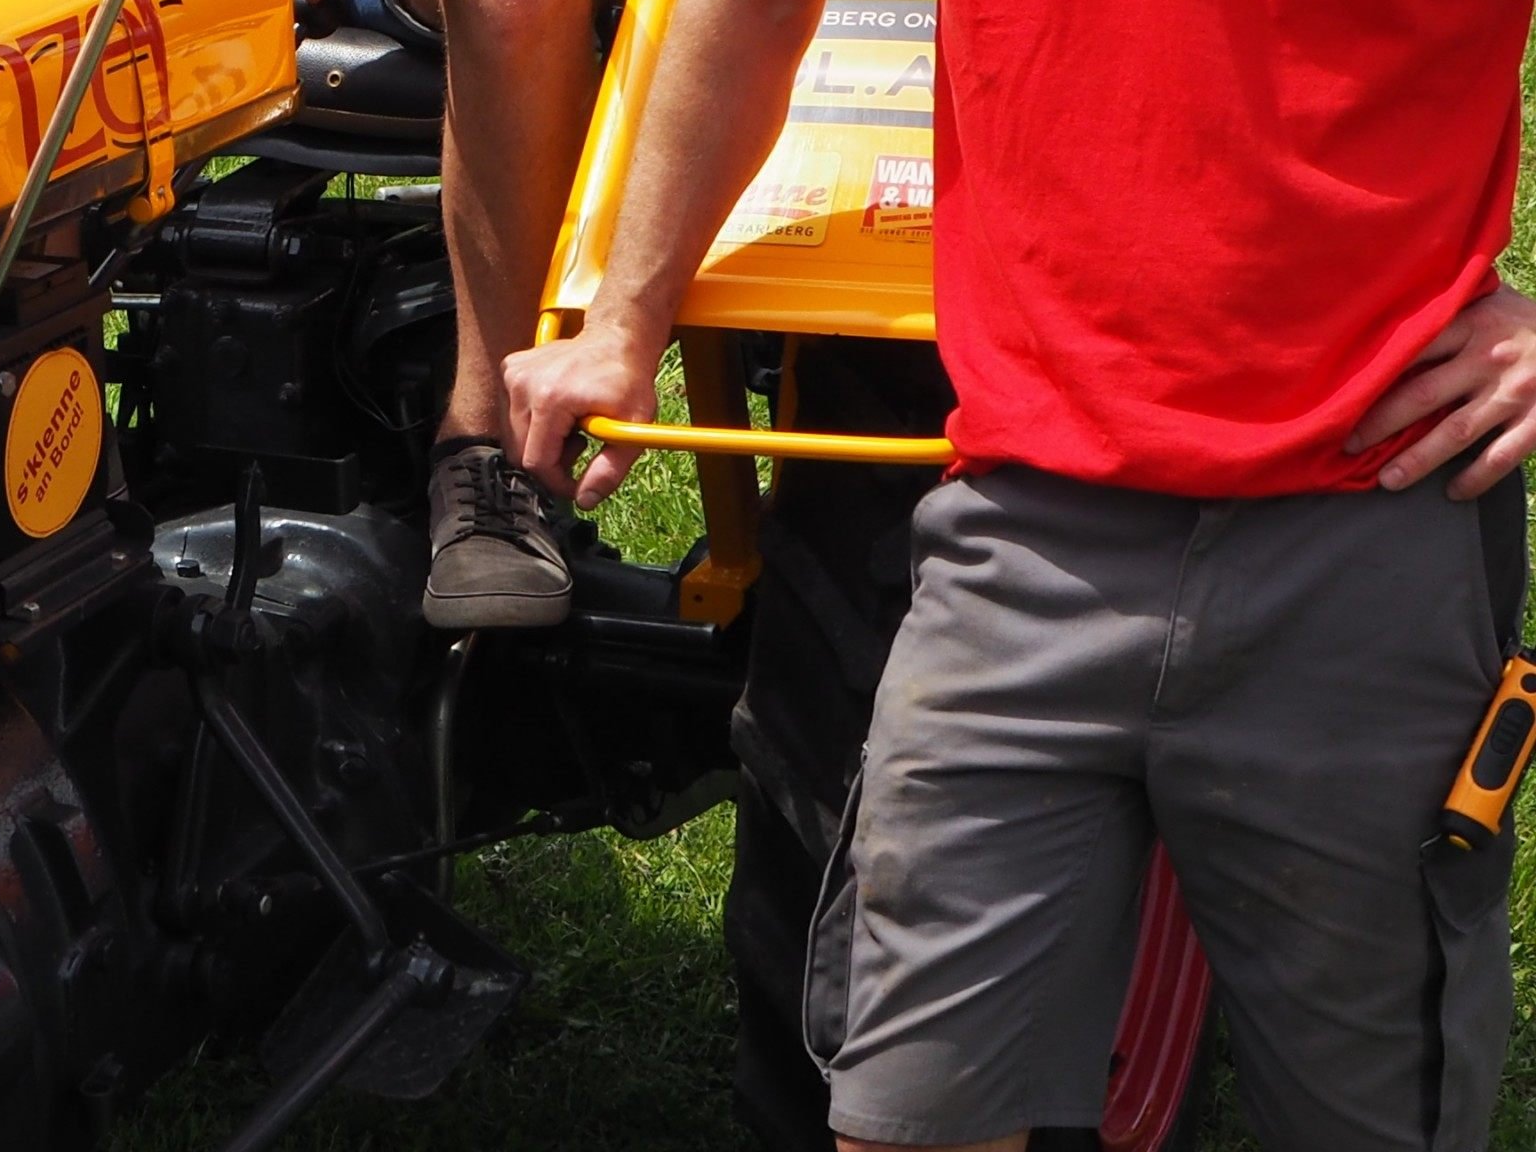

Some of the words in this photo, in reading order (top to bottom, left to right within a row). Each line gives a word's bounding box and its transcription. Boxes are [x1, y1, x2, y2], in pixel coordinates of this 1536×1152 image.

[16, 369, 81, 505] s'klenne
[35, 471, 52, 503] an
[48, 401, 85, 469] Bord!
